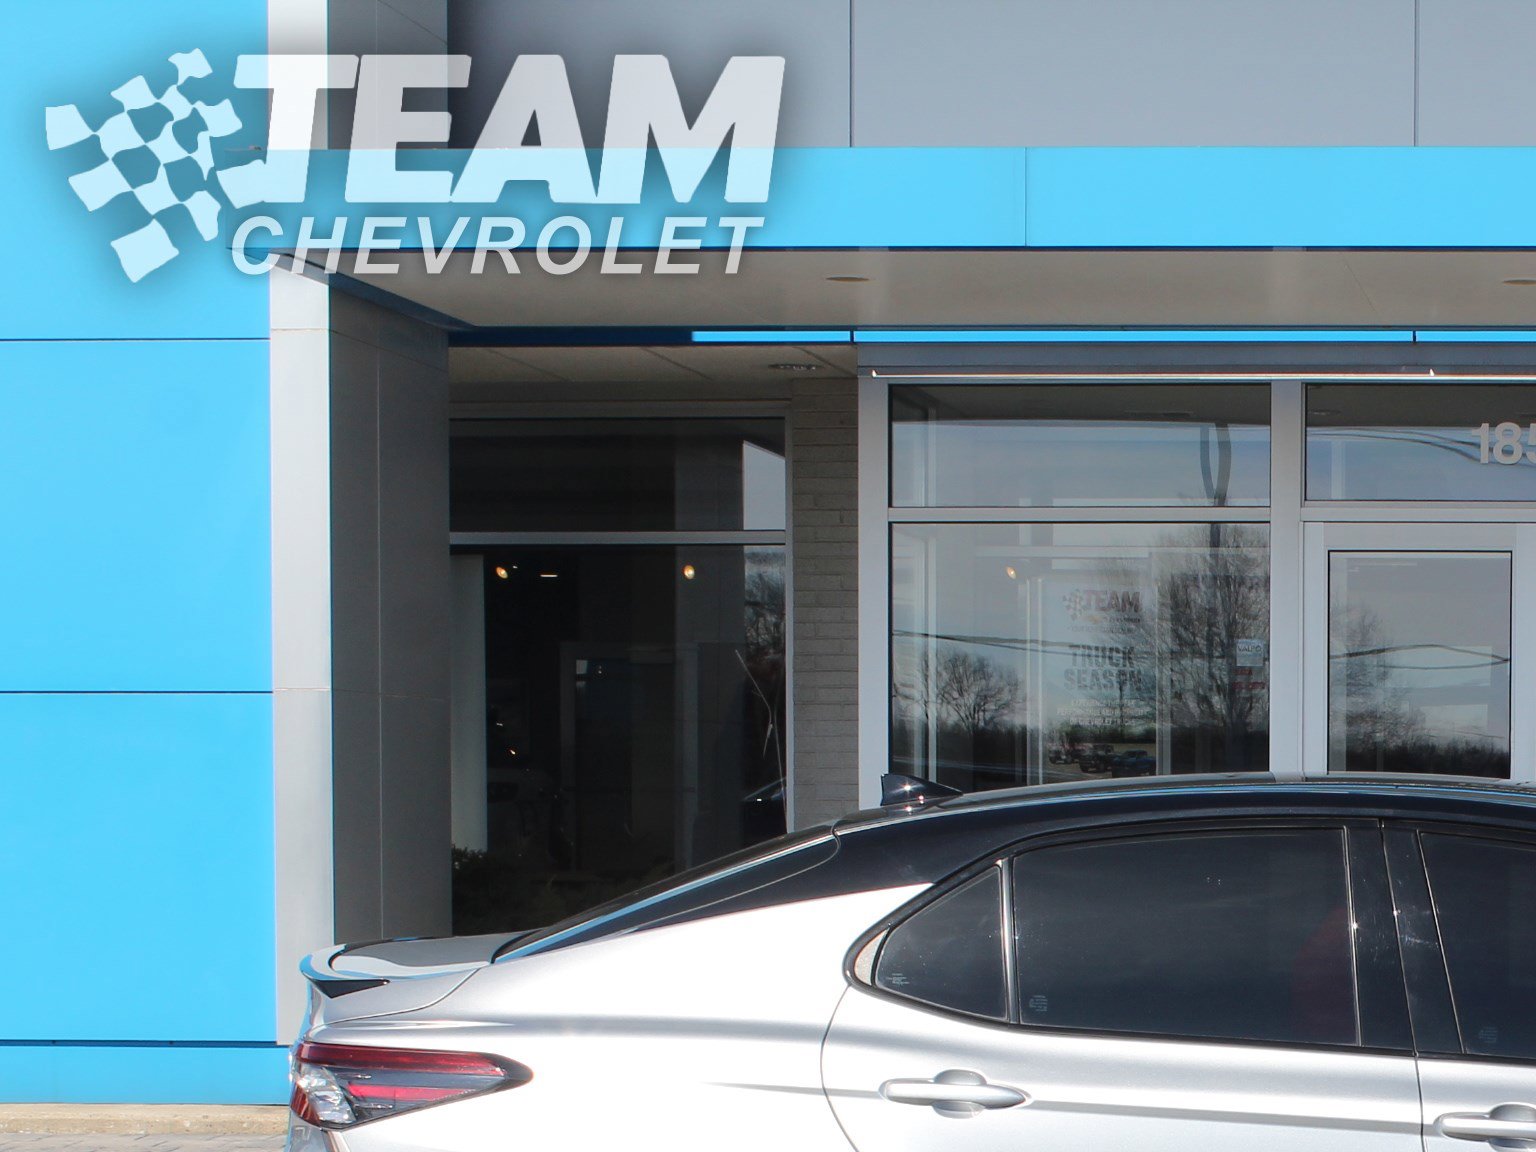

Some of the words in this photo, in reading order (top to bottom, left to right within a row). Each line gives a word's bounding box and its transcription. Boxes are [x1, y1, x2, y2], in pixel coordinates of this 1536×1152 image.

[1083, 589, 1141, 613] TEAM
[1070, 643, 1134, 668] TRUCK
[1063, 669, 1142, 691] SEASON
